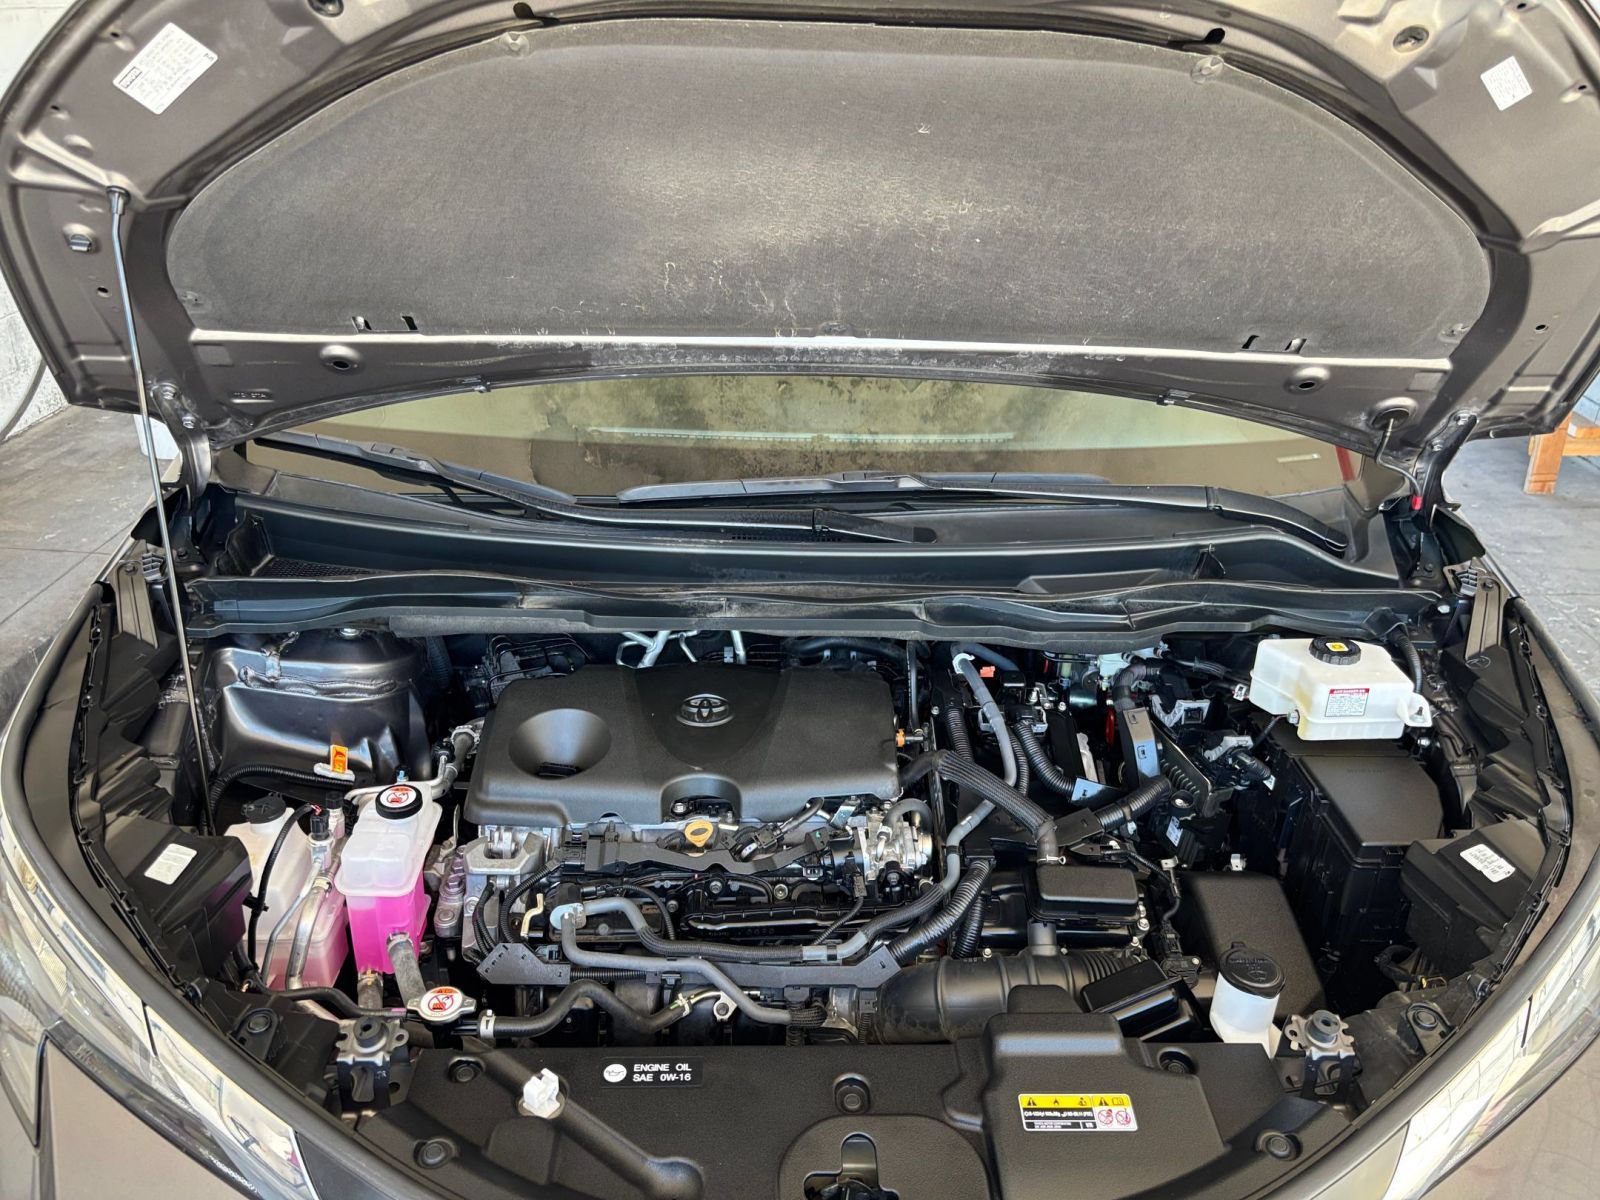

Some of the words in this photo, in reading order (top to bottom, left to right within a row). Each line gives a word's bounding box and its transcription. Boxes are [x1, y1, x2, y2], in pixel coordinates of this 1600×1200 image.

[633, 1063, 670, 1072] ENGINE
[675, 1063, 692, 1071] OIL
[632, 1073, 654, 1082] SAE
[660, 1073, 691, 1081] 0W-16
